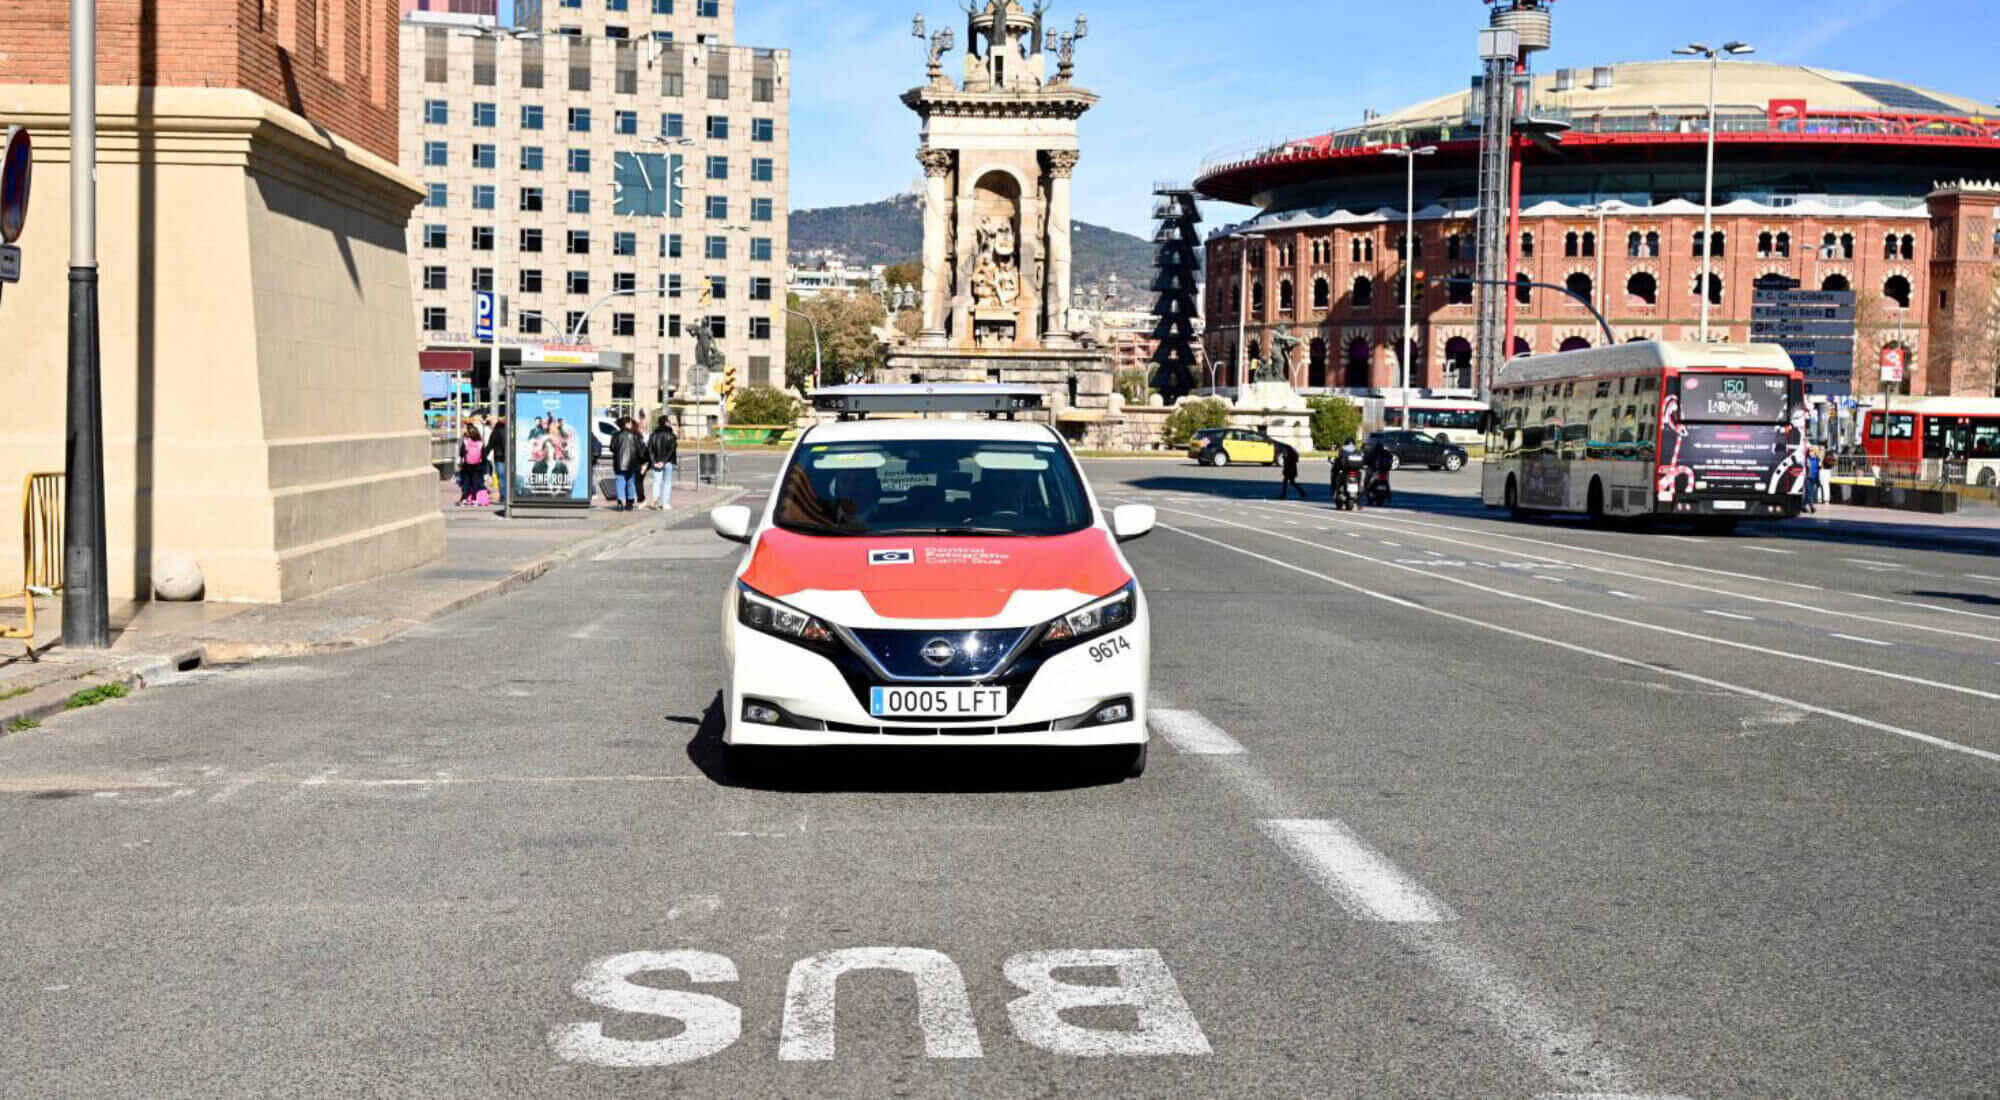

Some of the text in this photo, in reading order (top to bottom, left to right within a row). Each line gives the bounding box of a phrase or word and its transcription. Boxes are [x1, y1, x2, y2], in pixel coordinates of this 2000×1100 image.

[1723, 379, 1744, 393] 150
[1088, 635, 1131, 663] 9674
[888, 690, 1000, 712] 0005 LFT
[544, 946, 1214, 1067] BUS
